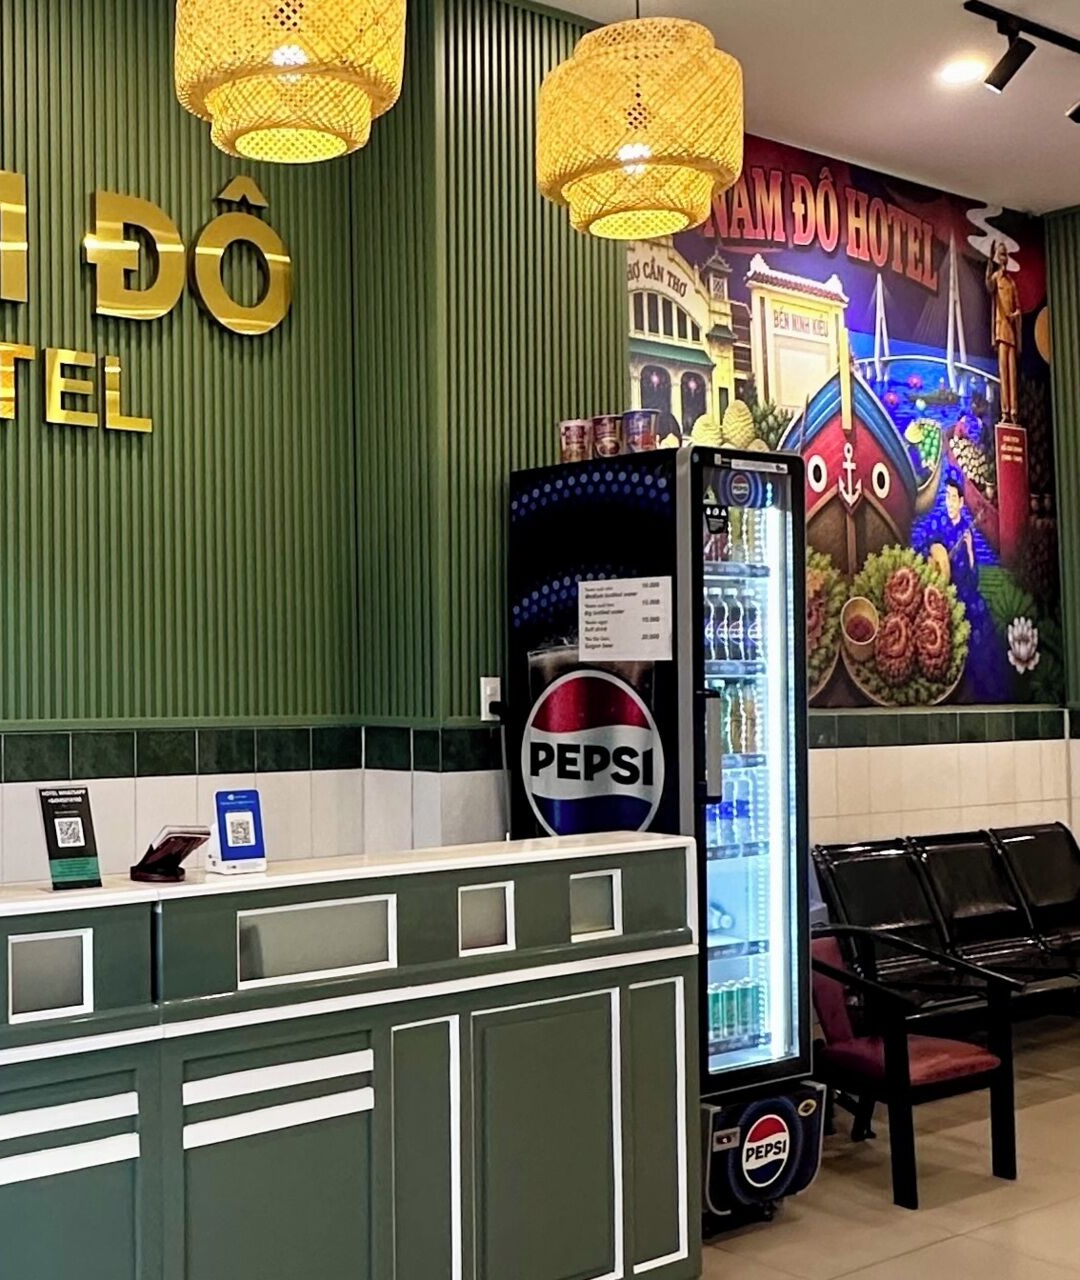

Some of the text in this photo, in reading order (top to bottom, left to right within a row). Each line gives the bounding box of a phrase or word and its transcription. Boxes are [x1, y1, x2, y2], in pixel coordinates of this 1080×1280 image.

[703, 167, 939, 292] NAM ĐÔ HOTEL
[82, 176, 294, 335] ĐÔ
[667, 270, 688, 298] THƠ
[529, 740, 654, 787] PEPSI
[745, 1139, 787, 1163] PEPSI
